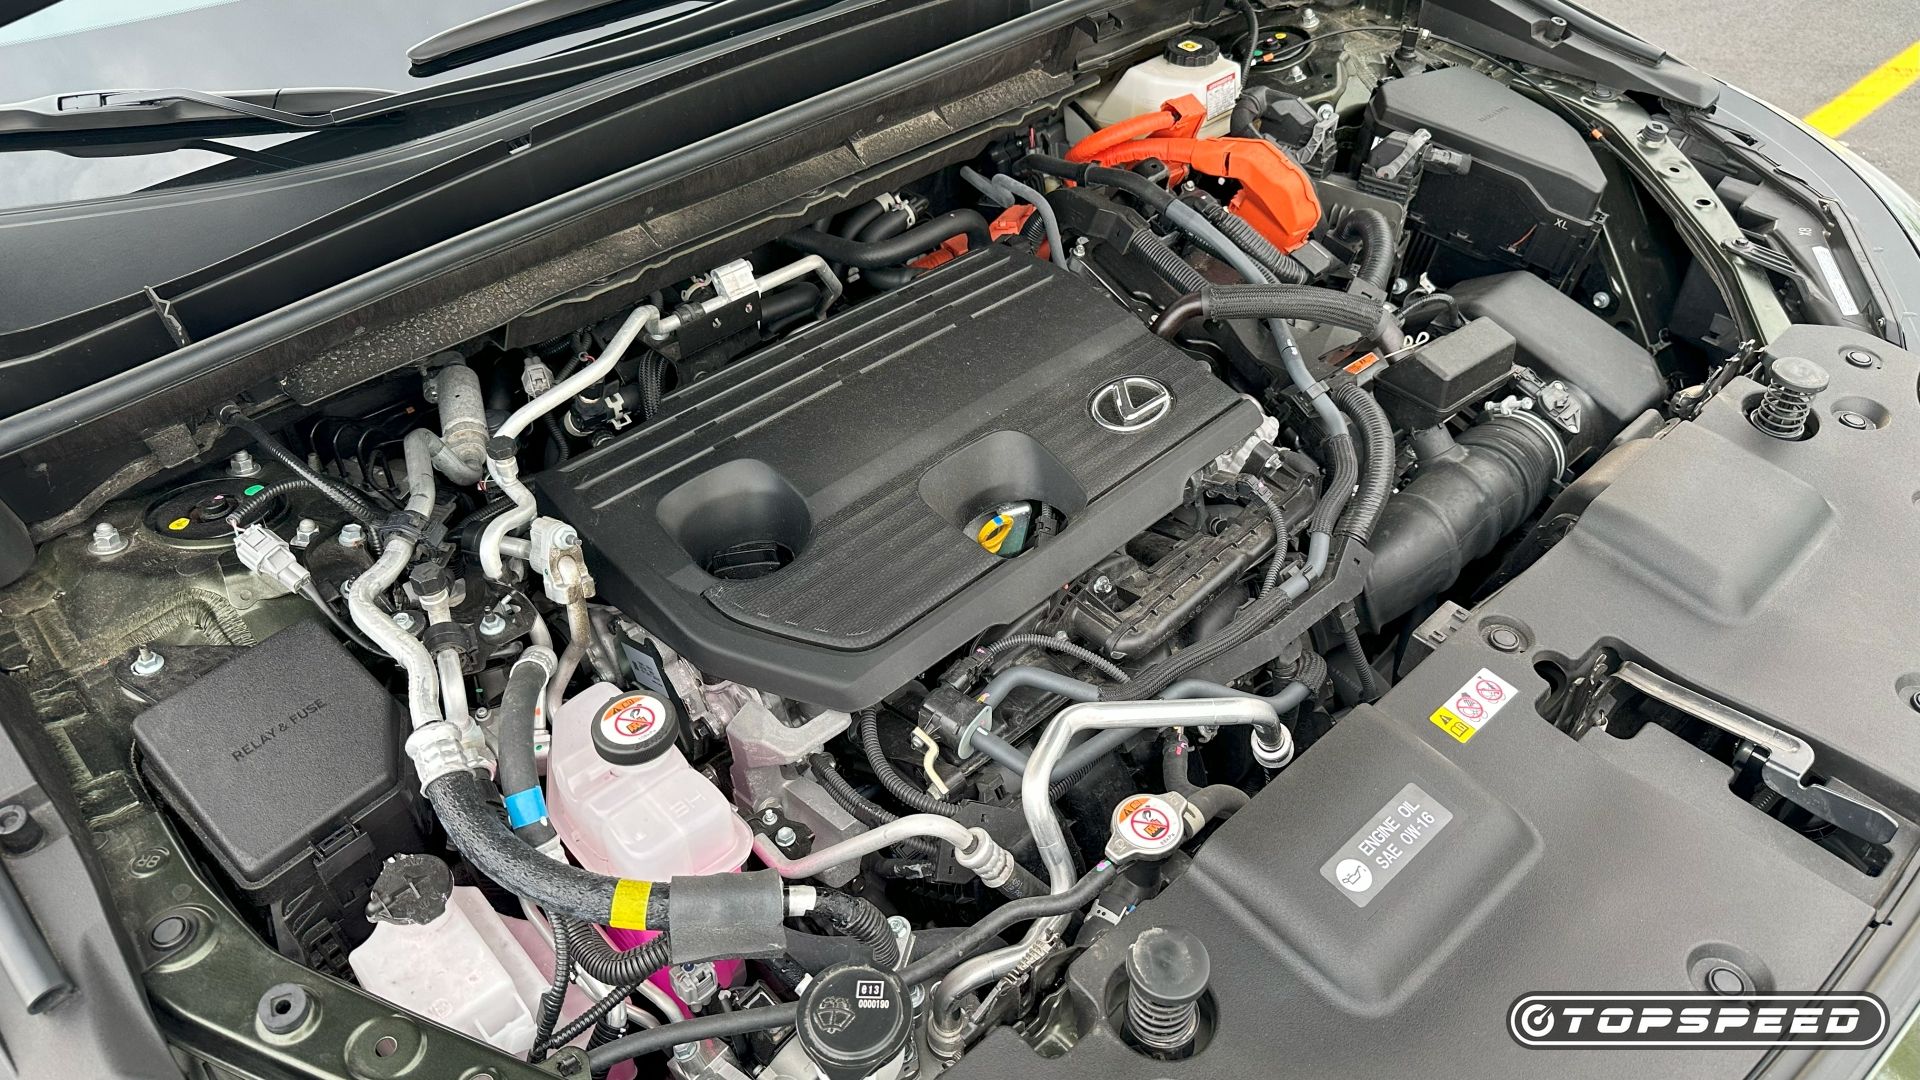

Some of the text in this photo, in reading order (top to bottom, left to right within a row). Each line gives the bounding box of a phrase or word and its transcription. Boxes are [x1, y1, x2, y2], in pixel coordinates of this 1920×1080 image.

[1553, 218, 1568, 231] XL
[231, 699, 327, 762] RELAY & FUSE
[1358, 800, 1421, 857] ENGINE OIL
[1375, 811, 1435, 869] SAE 0W-16
[858, 999, 890, 1009] 0000190
